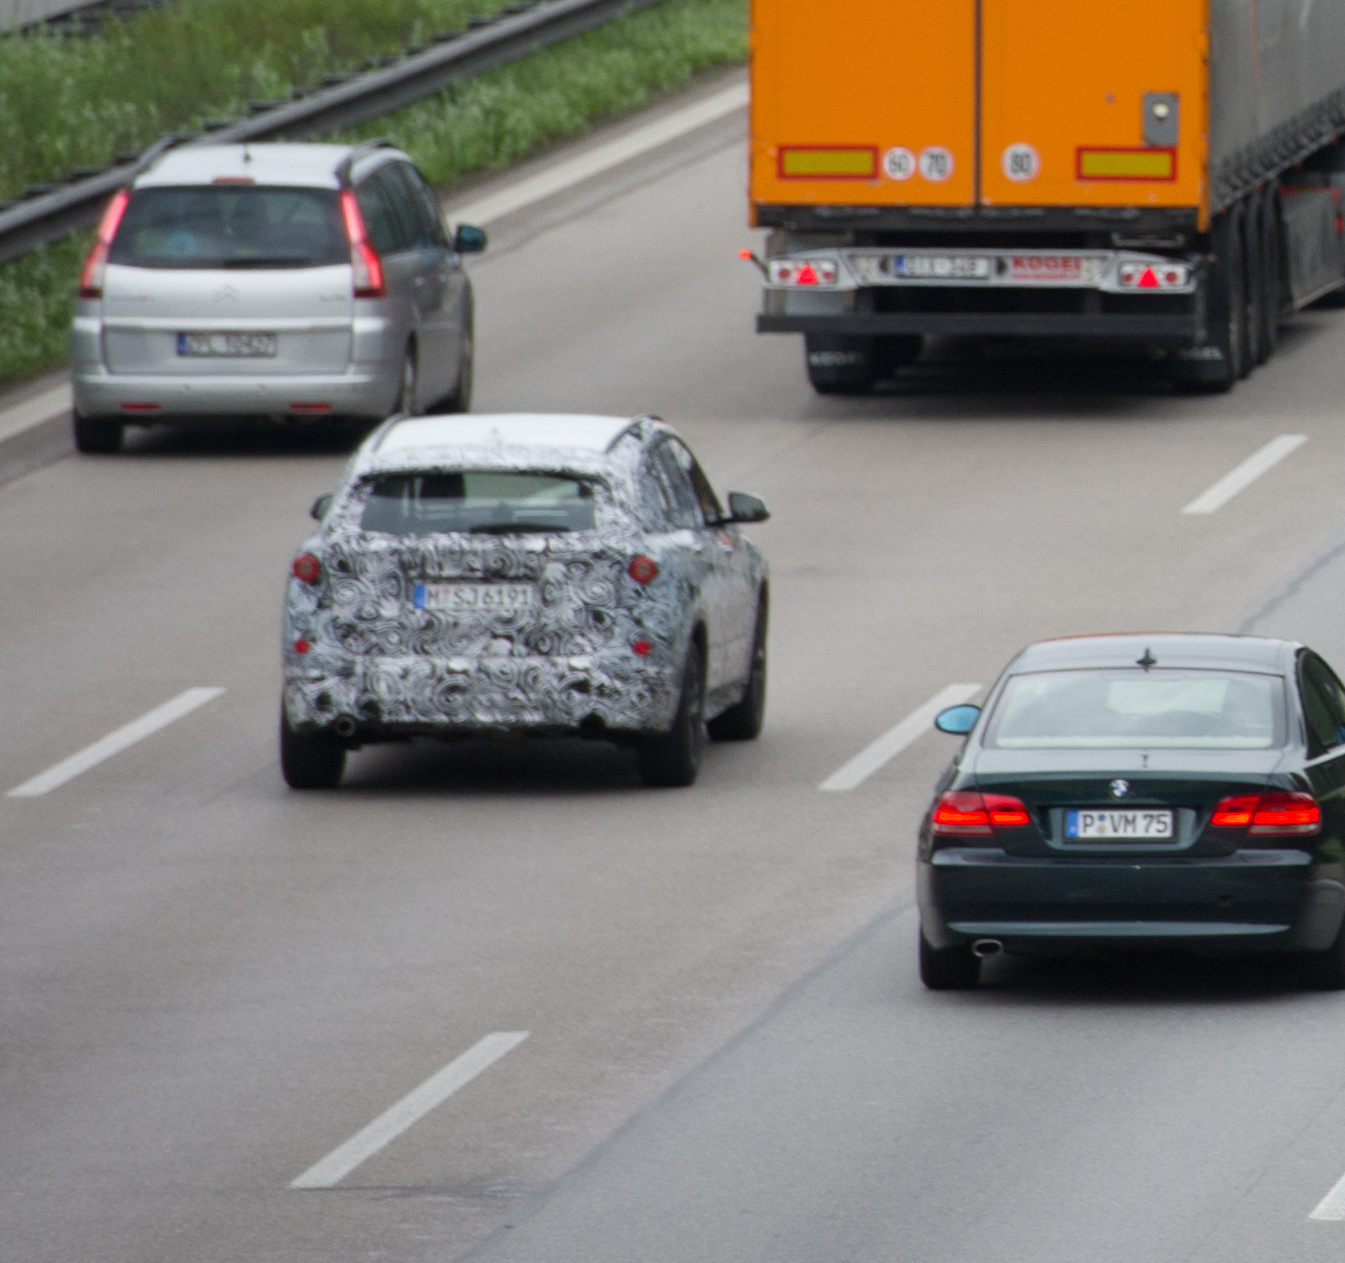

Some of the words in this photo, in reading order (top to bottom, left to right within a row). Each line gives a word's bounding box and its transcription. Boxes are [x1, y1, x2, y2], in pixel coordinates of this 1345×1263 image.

[889, 152, 908, 173] 60
[927, 151, 945, 174] 70
[1011, 153, 1031, 174] 80
[1083, 814, 1095, 834] P
[1109, 813, 1137, 834] VM
[1143, 813, 1169, 834] 75
